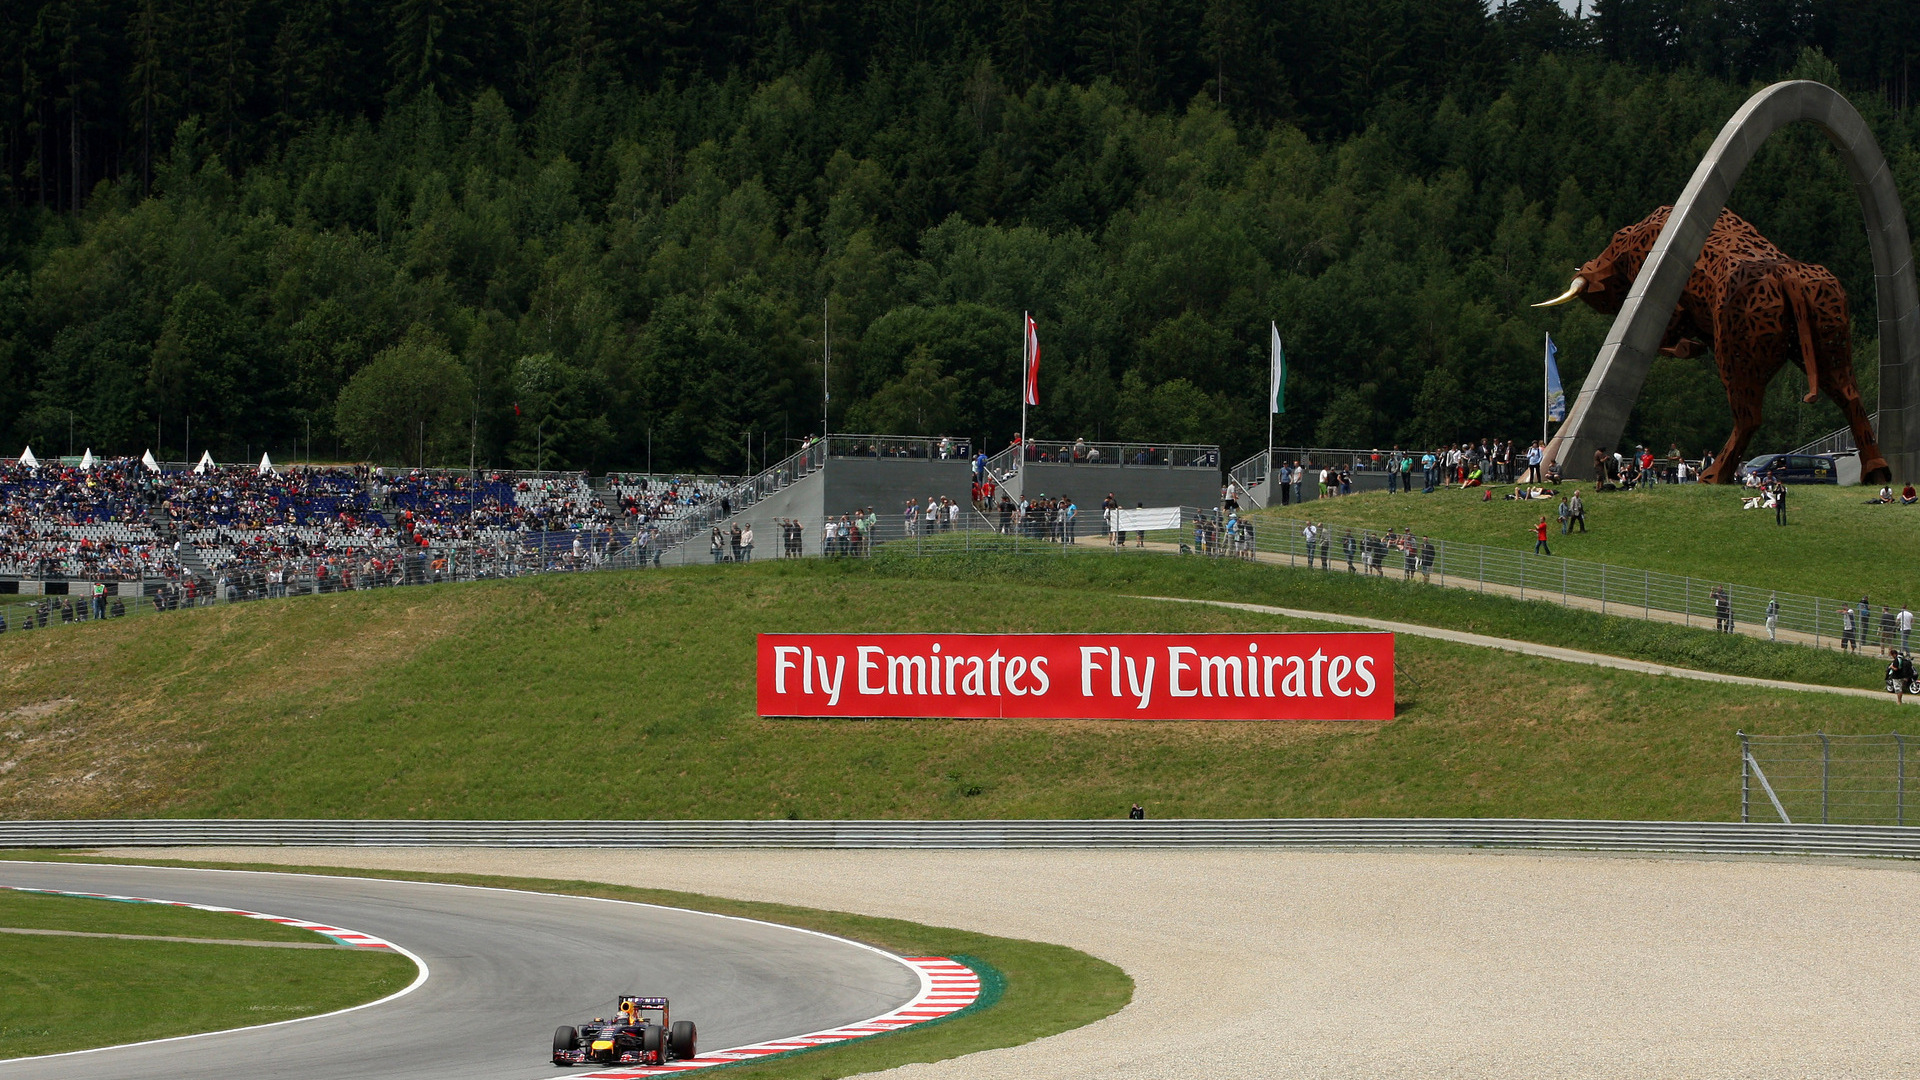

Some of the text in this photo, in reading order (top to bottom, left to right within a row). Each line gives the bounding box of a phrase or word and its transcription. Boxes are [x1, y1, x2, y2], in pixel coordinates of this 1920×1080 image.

[773, 642, 1376, 710] Fly Emirates Fly Emirates
